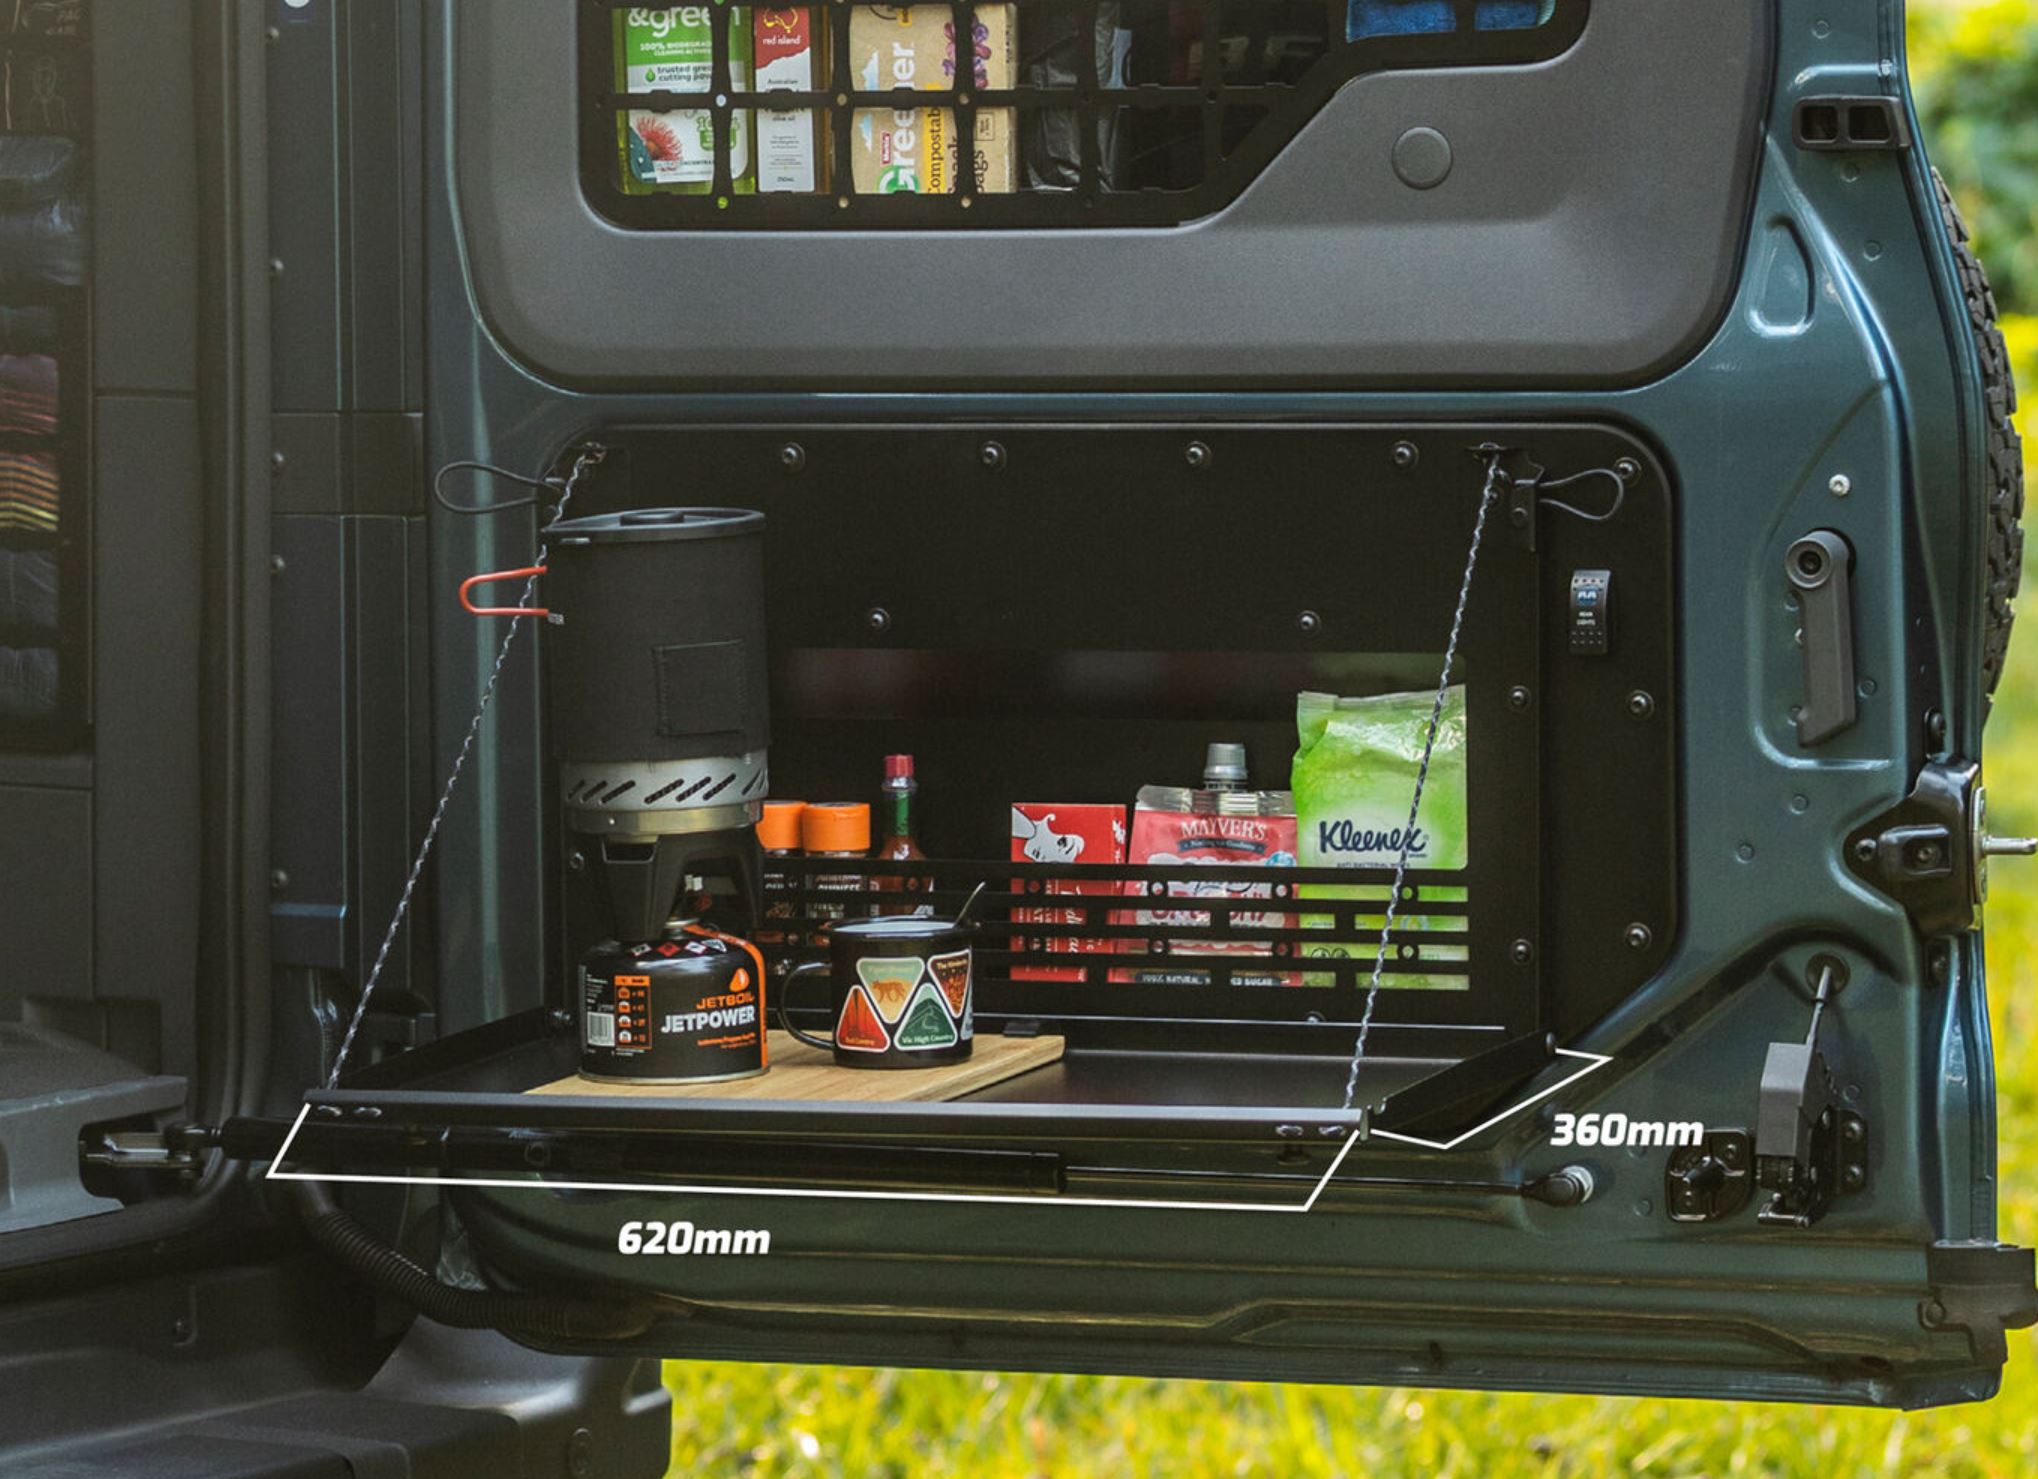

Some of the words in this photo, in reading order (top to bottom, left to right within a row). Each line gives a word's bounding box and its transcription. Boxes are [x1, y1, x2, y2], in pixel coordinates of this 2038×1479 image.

[763, 35, 776, 45] red
[778, 35, 801, 45] island
[1319, 819, 1426, 854] Kleenex
[696, 992, 755, 1010] JETBOIL
[661, 1005, 755, 1033] JETPOWER
